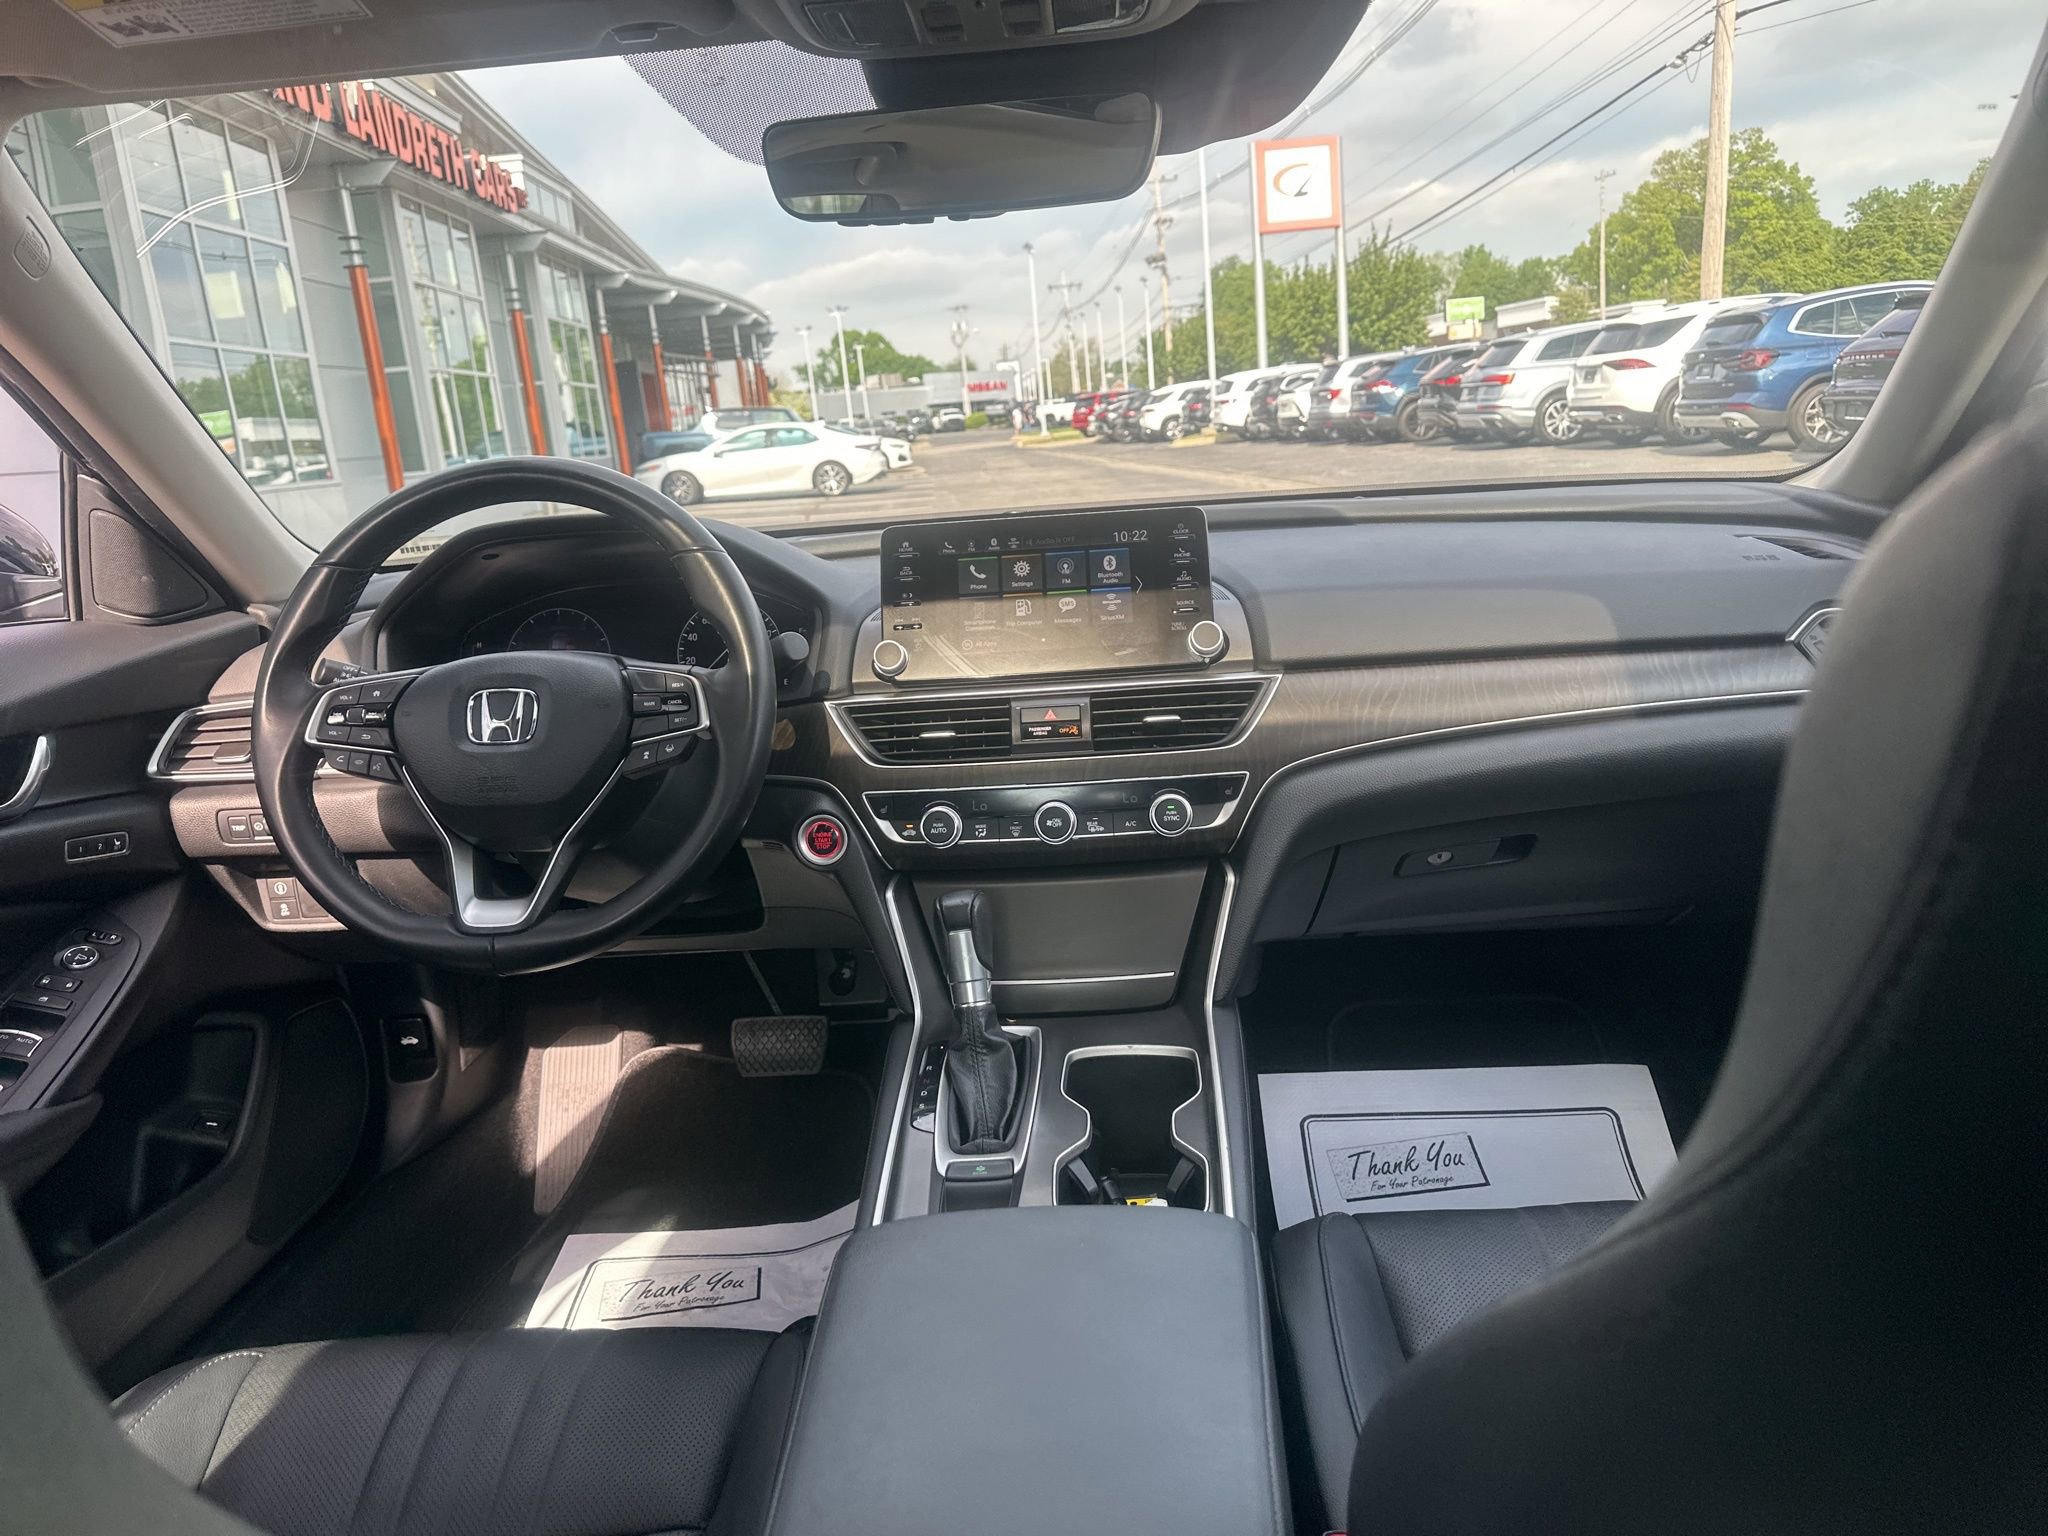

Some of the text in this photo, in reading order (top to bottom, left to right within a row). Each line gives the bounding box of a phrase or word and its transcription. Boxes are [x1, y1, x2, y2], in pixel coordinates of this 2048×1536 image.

[339, 80, 468, 191] LANDRETH
[470, 149, 519, 214] CARS
[1112, 529, 1148, 543] 10:22
[1060, 600, 1075, 608] SMS
[687, 633, 698, 642] 40
[685, 657, 696, 665] 20
[1163, 814, 1181, 822] SYNC
[1347, 1140, 1465, 1180] Thank You
[1370, 1175, 1454, 1191] For Your Patronage
[619, 1270, 744, 1303] Thank You
[632, 1294, 725, 1313] For Your Patronage
